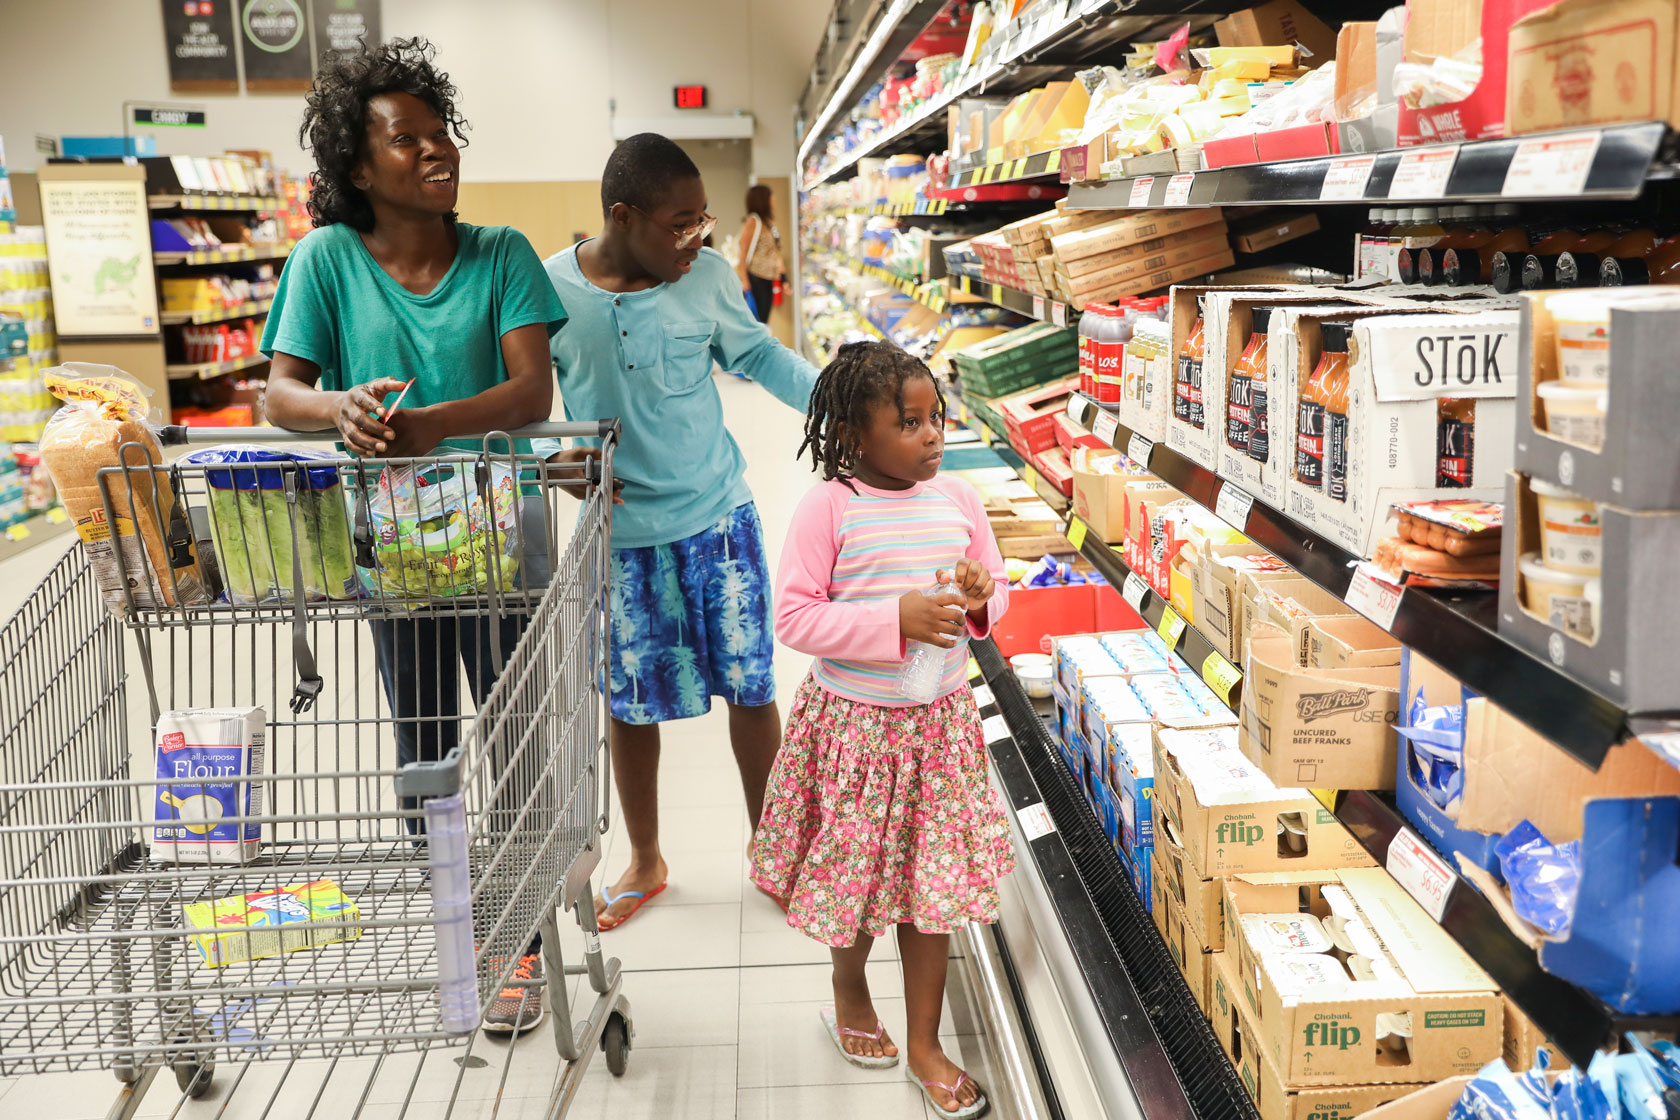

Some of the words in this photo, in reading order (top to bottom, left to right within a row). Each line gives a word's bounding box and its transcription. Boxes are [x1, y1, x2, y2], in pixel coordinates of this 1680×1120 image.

[1299, 691, 1334, 717] Ball
[1333, 687, 1368, 708] Park
[1353, 710, 1383, 723] USE
[1314, 738, 1351, 746] FRANKS
[191, 752, 200, 760] all
[202, 754, 236, 762] purpose
[173, 760, 236, 779] Flour
[1215, 821, 1264, 847] flip
[1422, 870, 1443, 901] $6.95
[1303, 1021, 1361, 1050] flip
